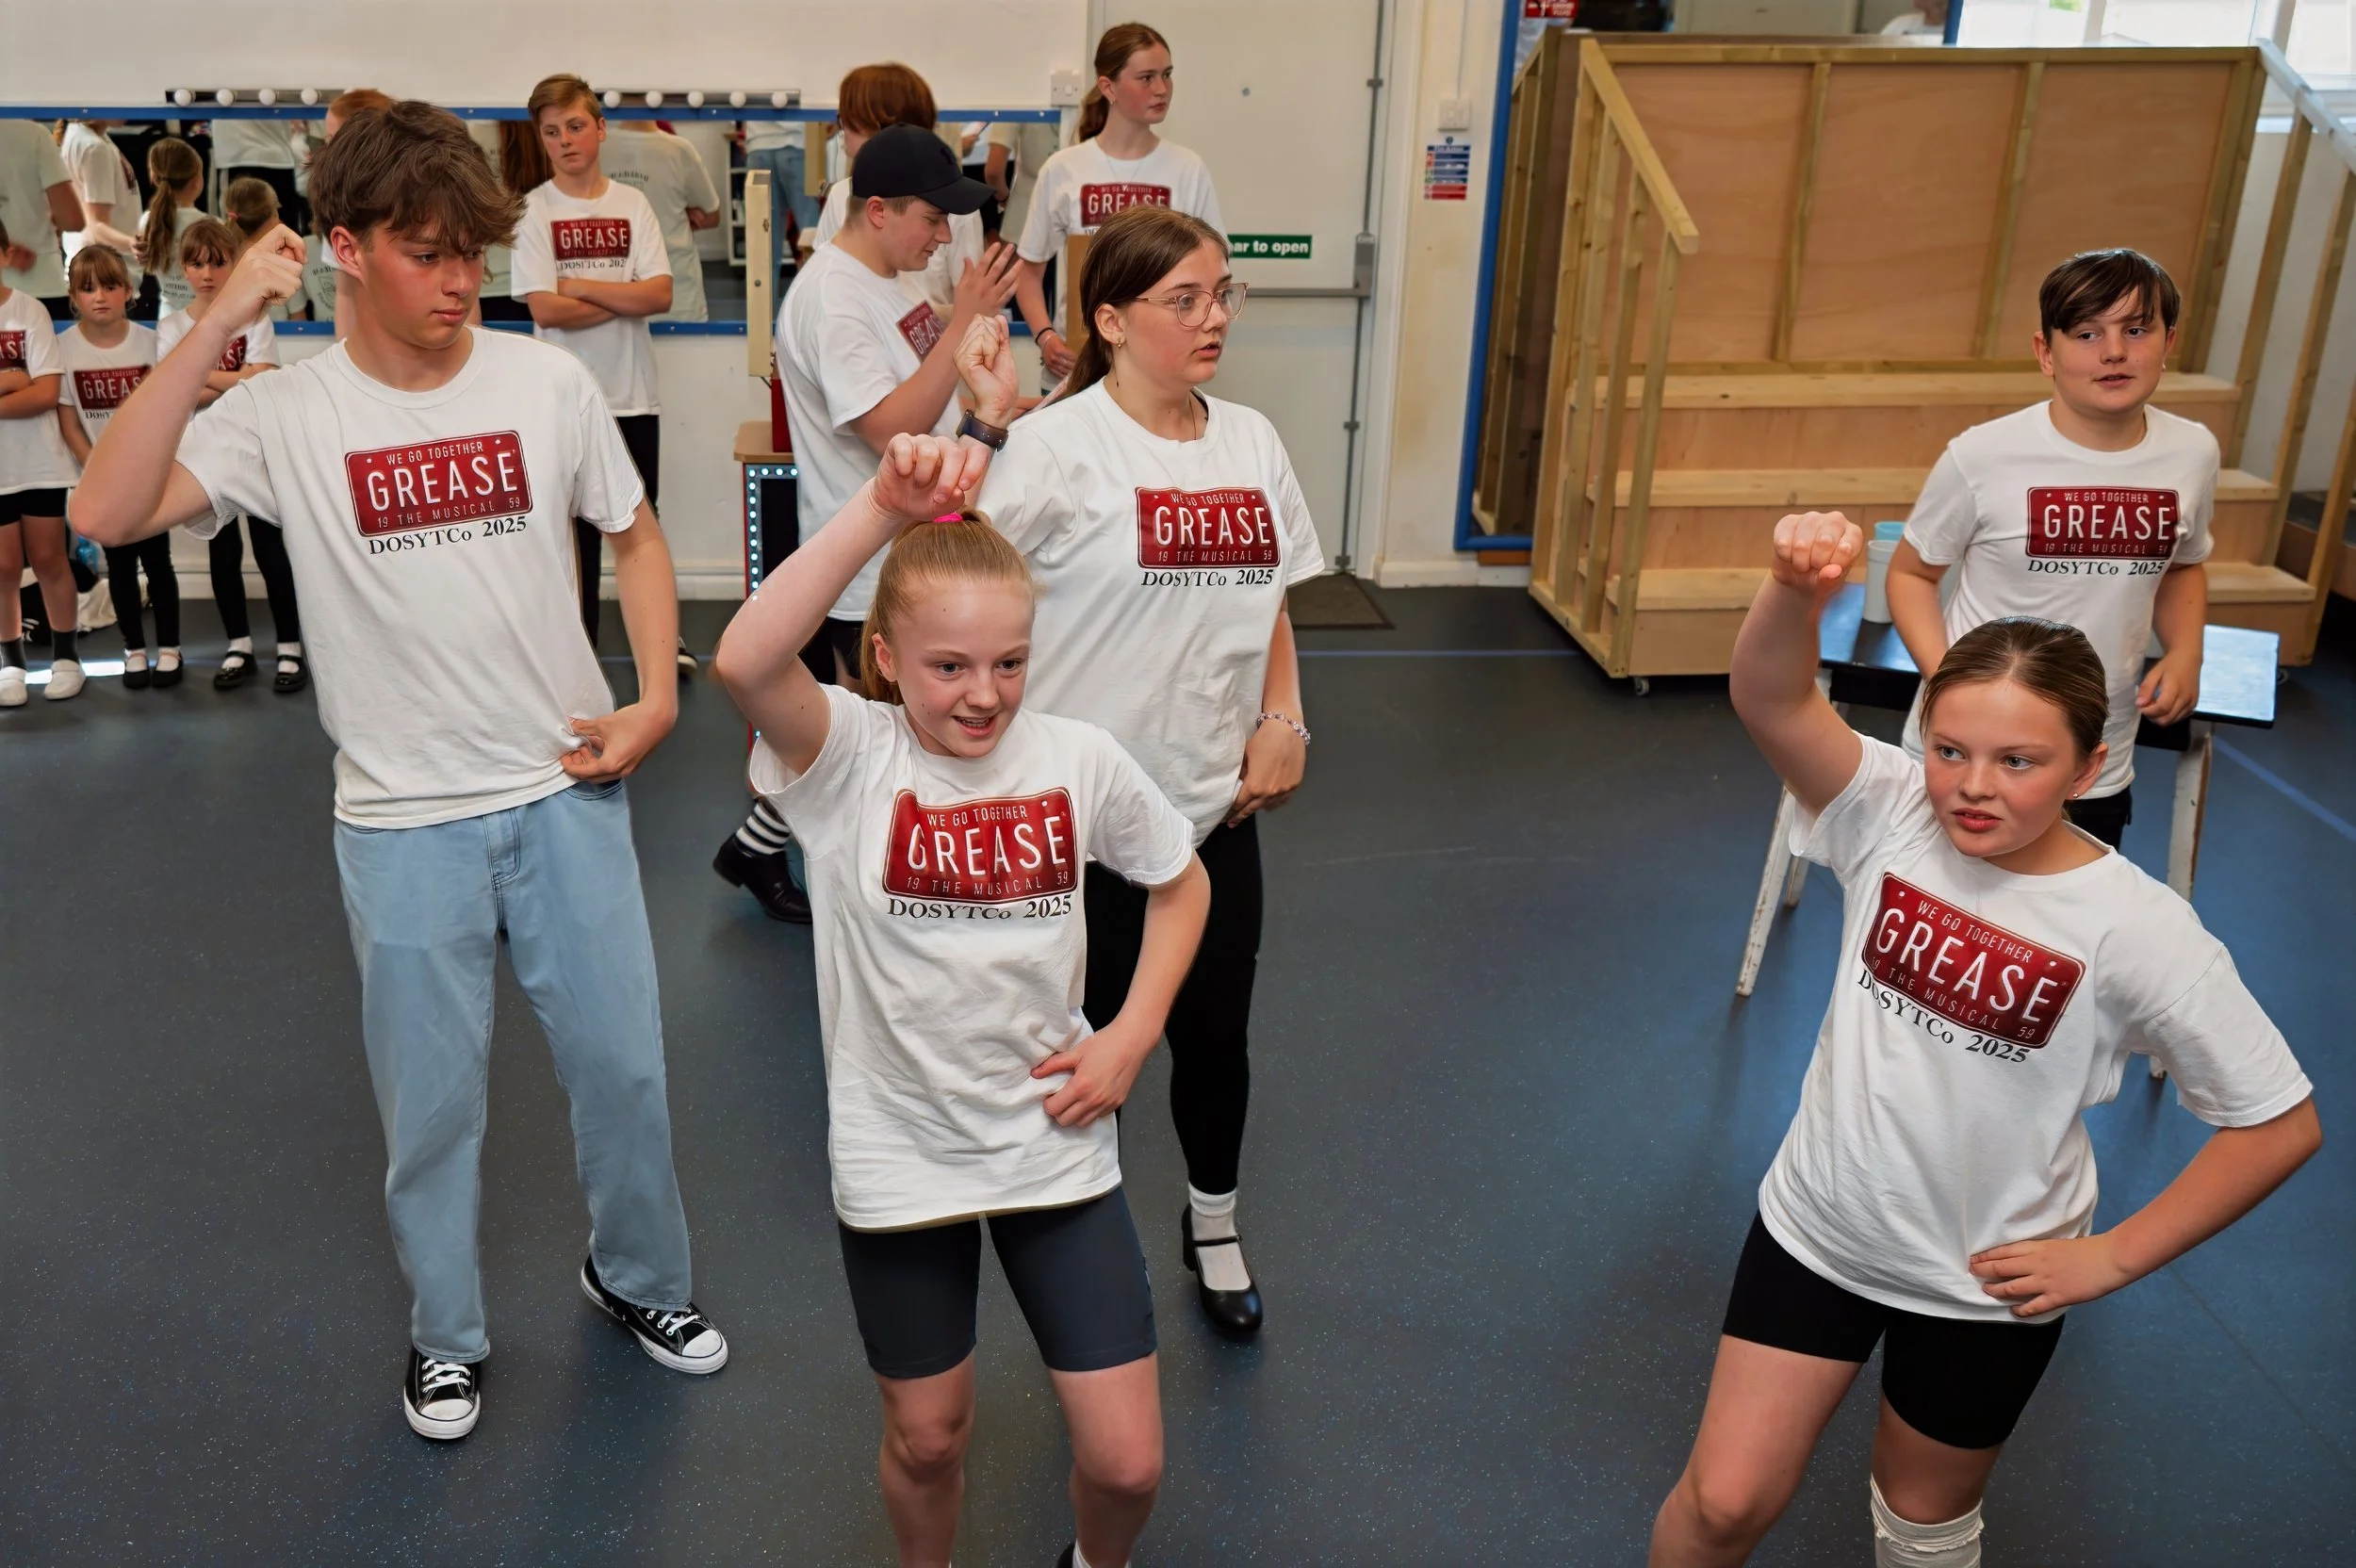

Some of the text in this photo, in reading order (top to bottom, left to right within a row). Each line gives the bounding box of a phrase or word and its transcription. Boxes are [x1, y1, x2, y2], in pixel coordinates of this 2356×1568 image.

[560, 227, 628, 250] GREASE
[1231, 239, 1309, 256] ar to open
[609, 258, 626, 269] 202
[83, 376, 140, 400] GREA
[386, 441, 483, 466] WE GO TOGETHER
[367, 452, 518, 512] GREASE
[1171, 493, 1245, 507] WE GO TOGETHER
[2064, 492, 2149, 503] WE GO TOGETHER
[377, 497, 520, 529] 19 THE MUSICAL 59
[2043, 504, 2171, 541] GREASE
[368, 515, 527, 555] DOSYTCo 2025
[1154, 505, 1271, 546] GREASE
[1158, 549, 1273, 563] 19 THE MUSICAL 59
[2062, 543, 2085, 553] THE
[2092, 544, 2146, 554] MUSICAL
[1140, 569, 1274, 587] DOSYTCo 2025
[2027, 559, 2167, 576] DOSYTCo 2025
[926, 805, 1027, 827] WE GO TOGETHER
[908, 815, 1067, 876] GREASE
[906, 876, 921, 890] 19
[932, 880, 961, 894] THE
[973, 875, 1042, 896] MUSICAL
[887, 893, 1072, 920] DOSYTCo 2025
[1917, 899, 2034, 963] WE GO TOGETHER
[1875, 907, 2059, 1023] GREASE
[1871, 956, 2037, 1039] 19 THE MUSICAL 59
[1965, 1034, 2031, 1064] 2025
